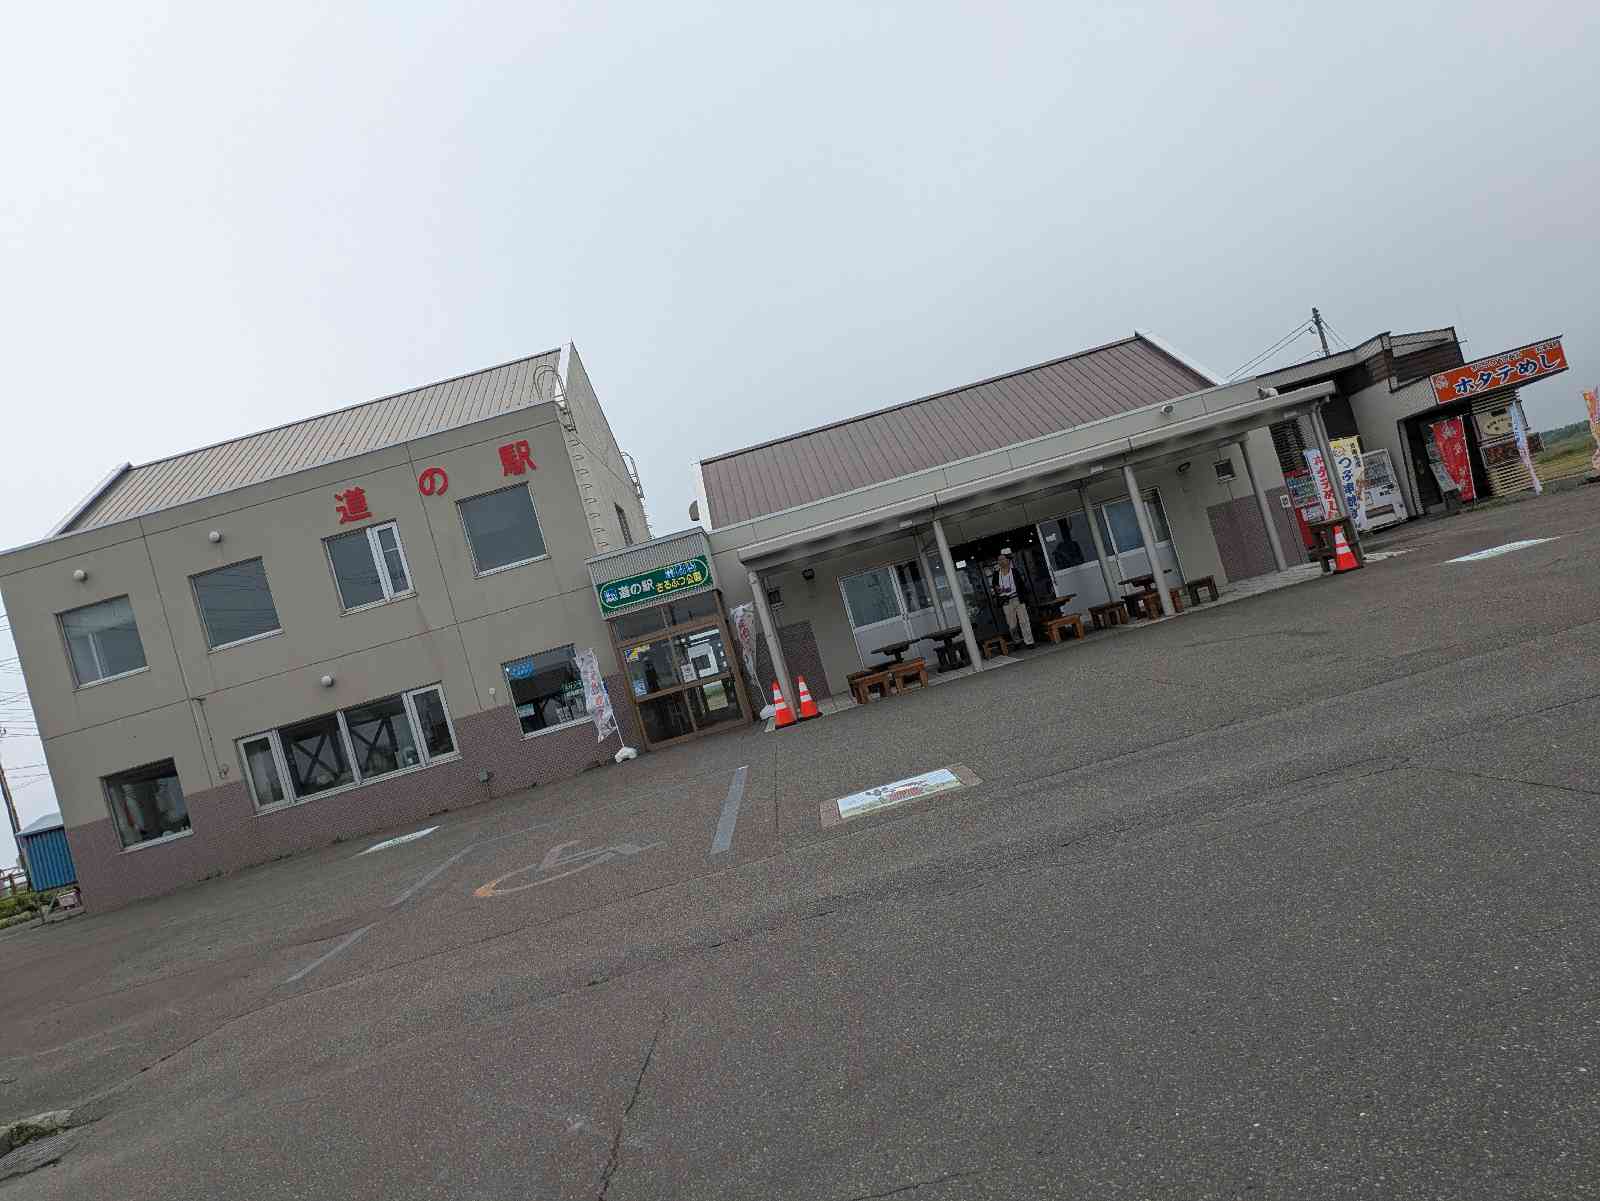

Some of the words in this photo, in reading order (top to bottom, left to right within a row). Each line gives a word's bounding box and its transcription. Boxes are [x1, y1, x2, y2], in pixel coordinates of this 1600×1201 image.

[1454, 352, 1562, 393] ホタテめし
[334, 439, 537, 525] 道の駅
[618, 578, 655, 600] 道の駅
